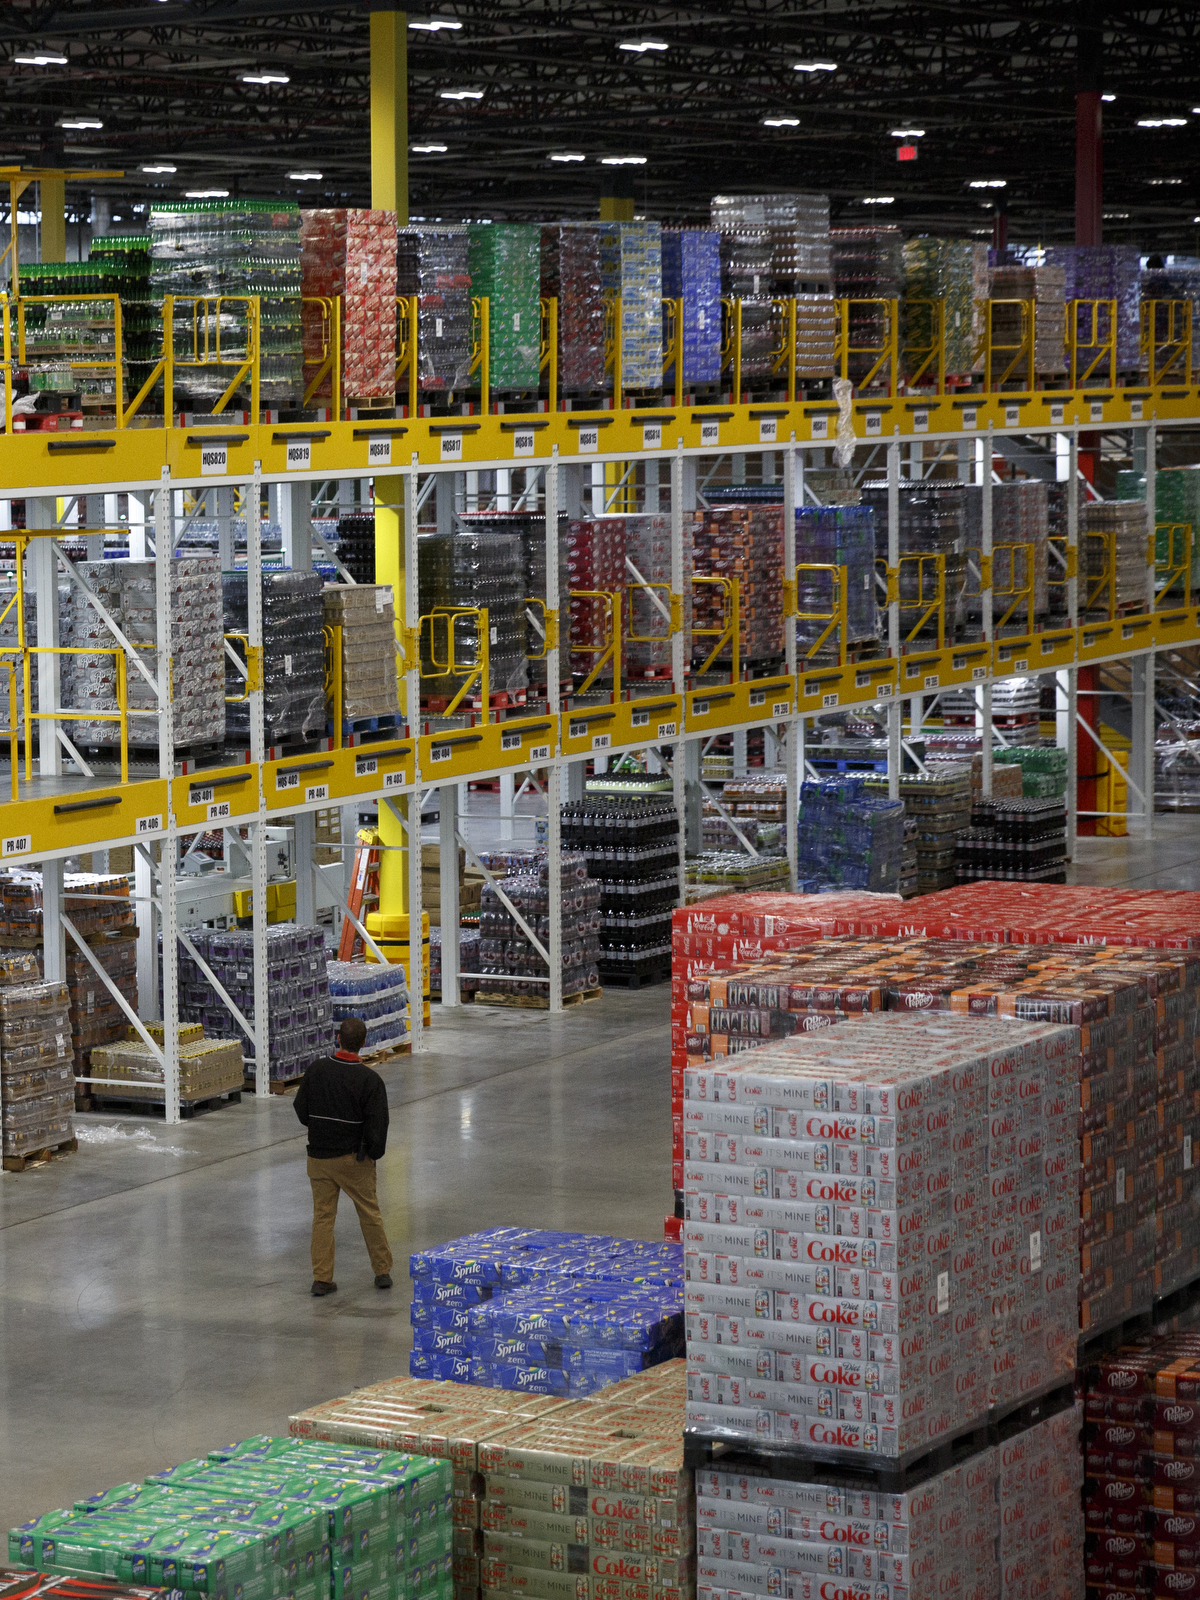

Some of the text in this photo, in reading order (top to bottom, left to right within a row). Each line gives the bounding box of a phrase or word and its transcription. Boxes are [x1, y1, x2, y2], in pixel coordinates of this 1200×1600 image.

[442, 439, 462, 453] HQS817
[515, 436, 533, 449] HQS816
[580, 433, 597, 446] HQS815
[288, 447, 310, 461] HQS819
[370, 443, 390, 457] HQS818
[202, 452, 226, 466] HQS820
[659, 725, 665, 736] PR
[431, 749, 440, 761] HQS
[533, 746, 547, 759] PR 402
[356, 760, 376, 774] HQS 403
[277, 774, 298, 788] HQS 402
[386, 773, 402, 786] PR 403
[190, 790, 212, 804] HQS 401
[308, 786, 325, 800] PR 404
[210, 804, 229, 818] PR 405
[139, 817, 159, 831] PR 406
[6, 838, 27, 852] PR 407
[905, 992, 933, 1008] Pepper
[745, 1086, 762, 1096] Coke
[783, 1086, 809, 1099] MINE
[686, 1112, 703, 1121] Coke
[724, 1113, 750, 1125] MINE
[839, 1115, 857, 1125] Diet
[806, 1118, 857, 1140] Coke
[745, 1147, 762, 1156] Coke
[784, 1149, 809, 1161] MINE
[686, 1172, 703, 1181] Coke
[724, 1174, 749, 1186] MINE
[839, 1178, 857, 1188] Diet
[806, 1179, 857, 1202] Coke
[840, 1239, 858, 1249] Diet
[807, 1241, 858, 1264] Coke
[454, 1260, 481, 1280] Sprite
[464, 1278, 481, 1286] zero
[434, 1285, 463, 1301] Sprite
[446, 1300, 463, 1308] zero
[518, 1315, 547, 1333] Sprite
[434, 1333, 462, 1349] Sprite
[529, 1333, 547, 1341] zero
[446, 1347, 462, 1355] zero
[496, 1341, 526, 1359] Sprite
[507, 1356, 526, 1365] zero
[517, 1368, 547, 1386] Sprite
[1108, 1373, 1136, 1387] Pepper
[529, 1385, 547, 1393] zero
[1164, 1408, 1192, 1423] Pepper
[508, 1459, 524, 1469] Coke
[543, 1464, 568, 1476] MINE
[591, 1496, 640, 1520] Coke
[622, 1496, 639, 1507] Diet
[592, 1555, 641, 1579] Coke
[623, 1555, 640, 1565] Diet
